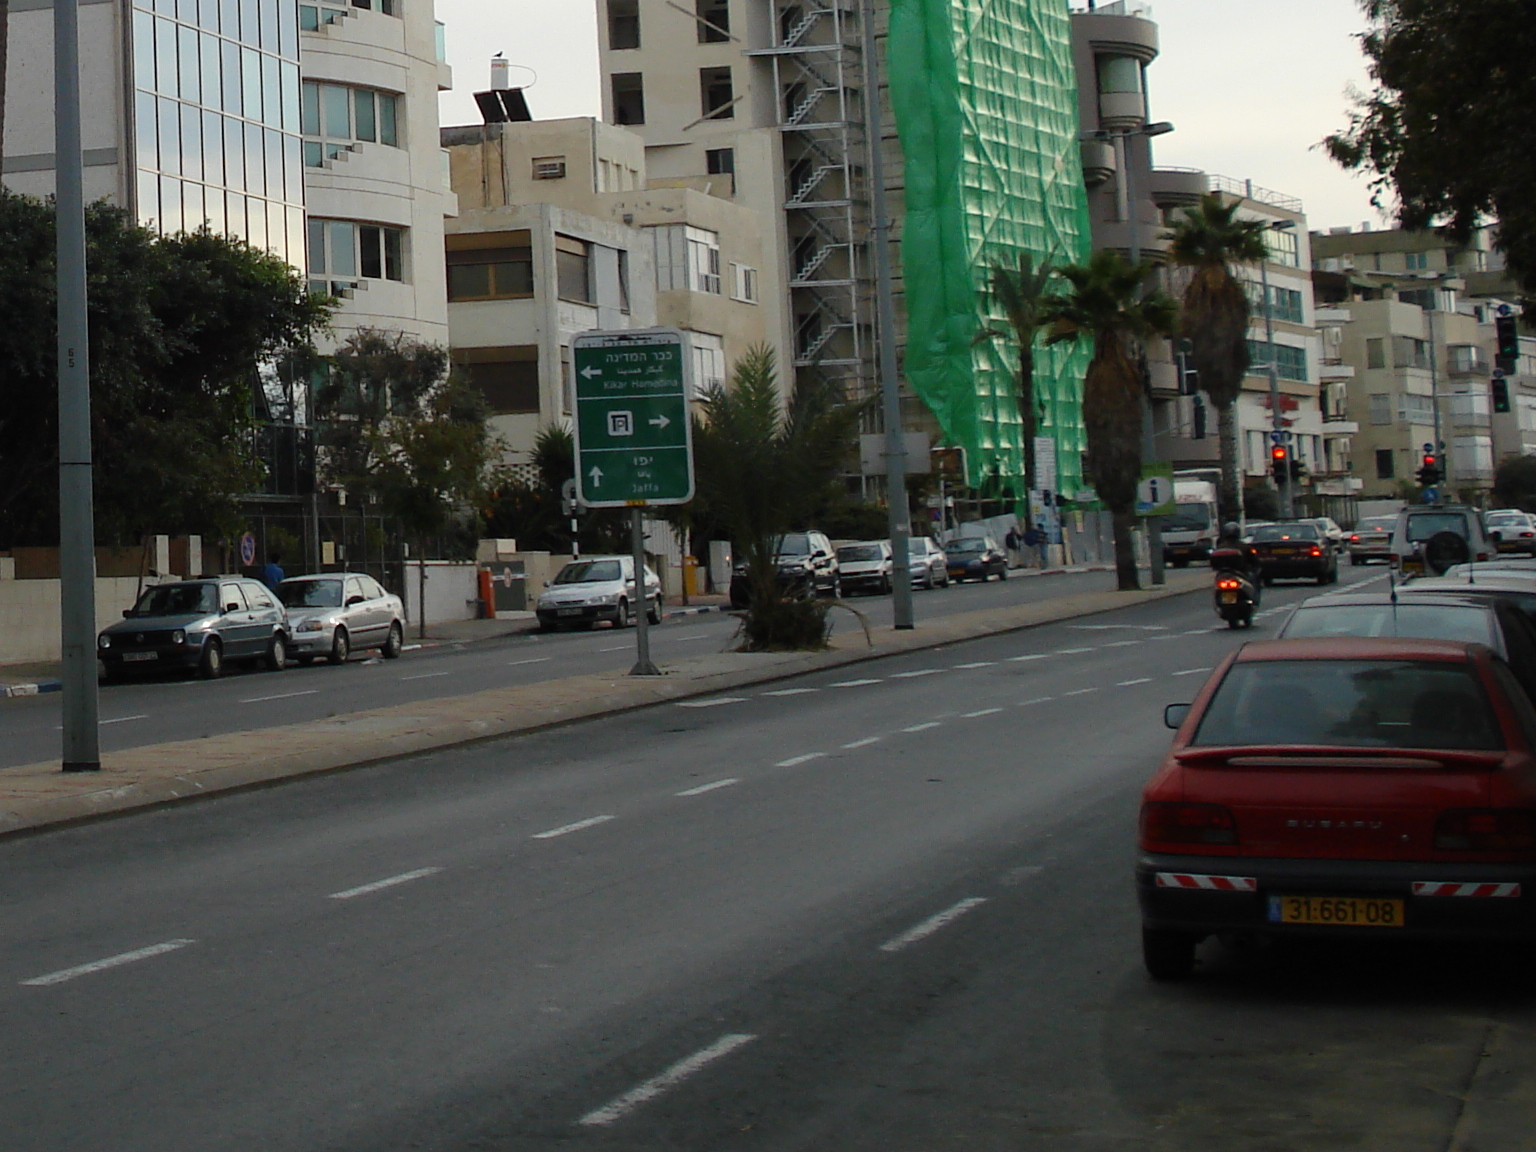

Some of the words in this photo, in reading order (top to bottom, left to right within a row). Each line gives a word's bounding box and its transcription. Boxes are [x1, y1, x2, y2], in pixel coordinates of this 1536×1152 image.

[606, 352, 647, 363] המדינה
[604, 381, 627, 389] Kikar
[632, 379, 678, 388] Hamedina
[634, 456, 653, 465] יפו
[633, 483, 659, 493] Jaffa
[1287, 819, 1383, 829] SUBARU
